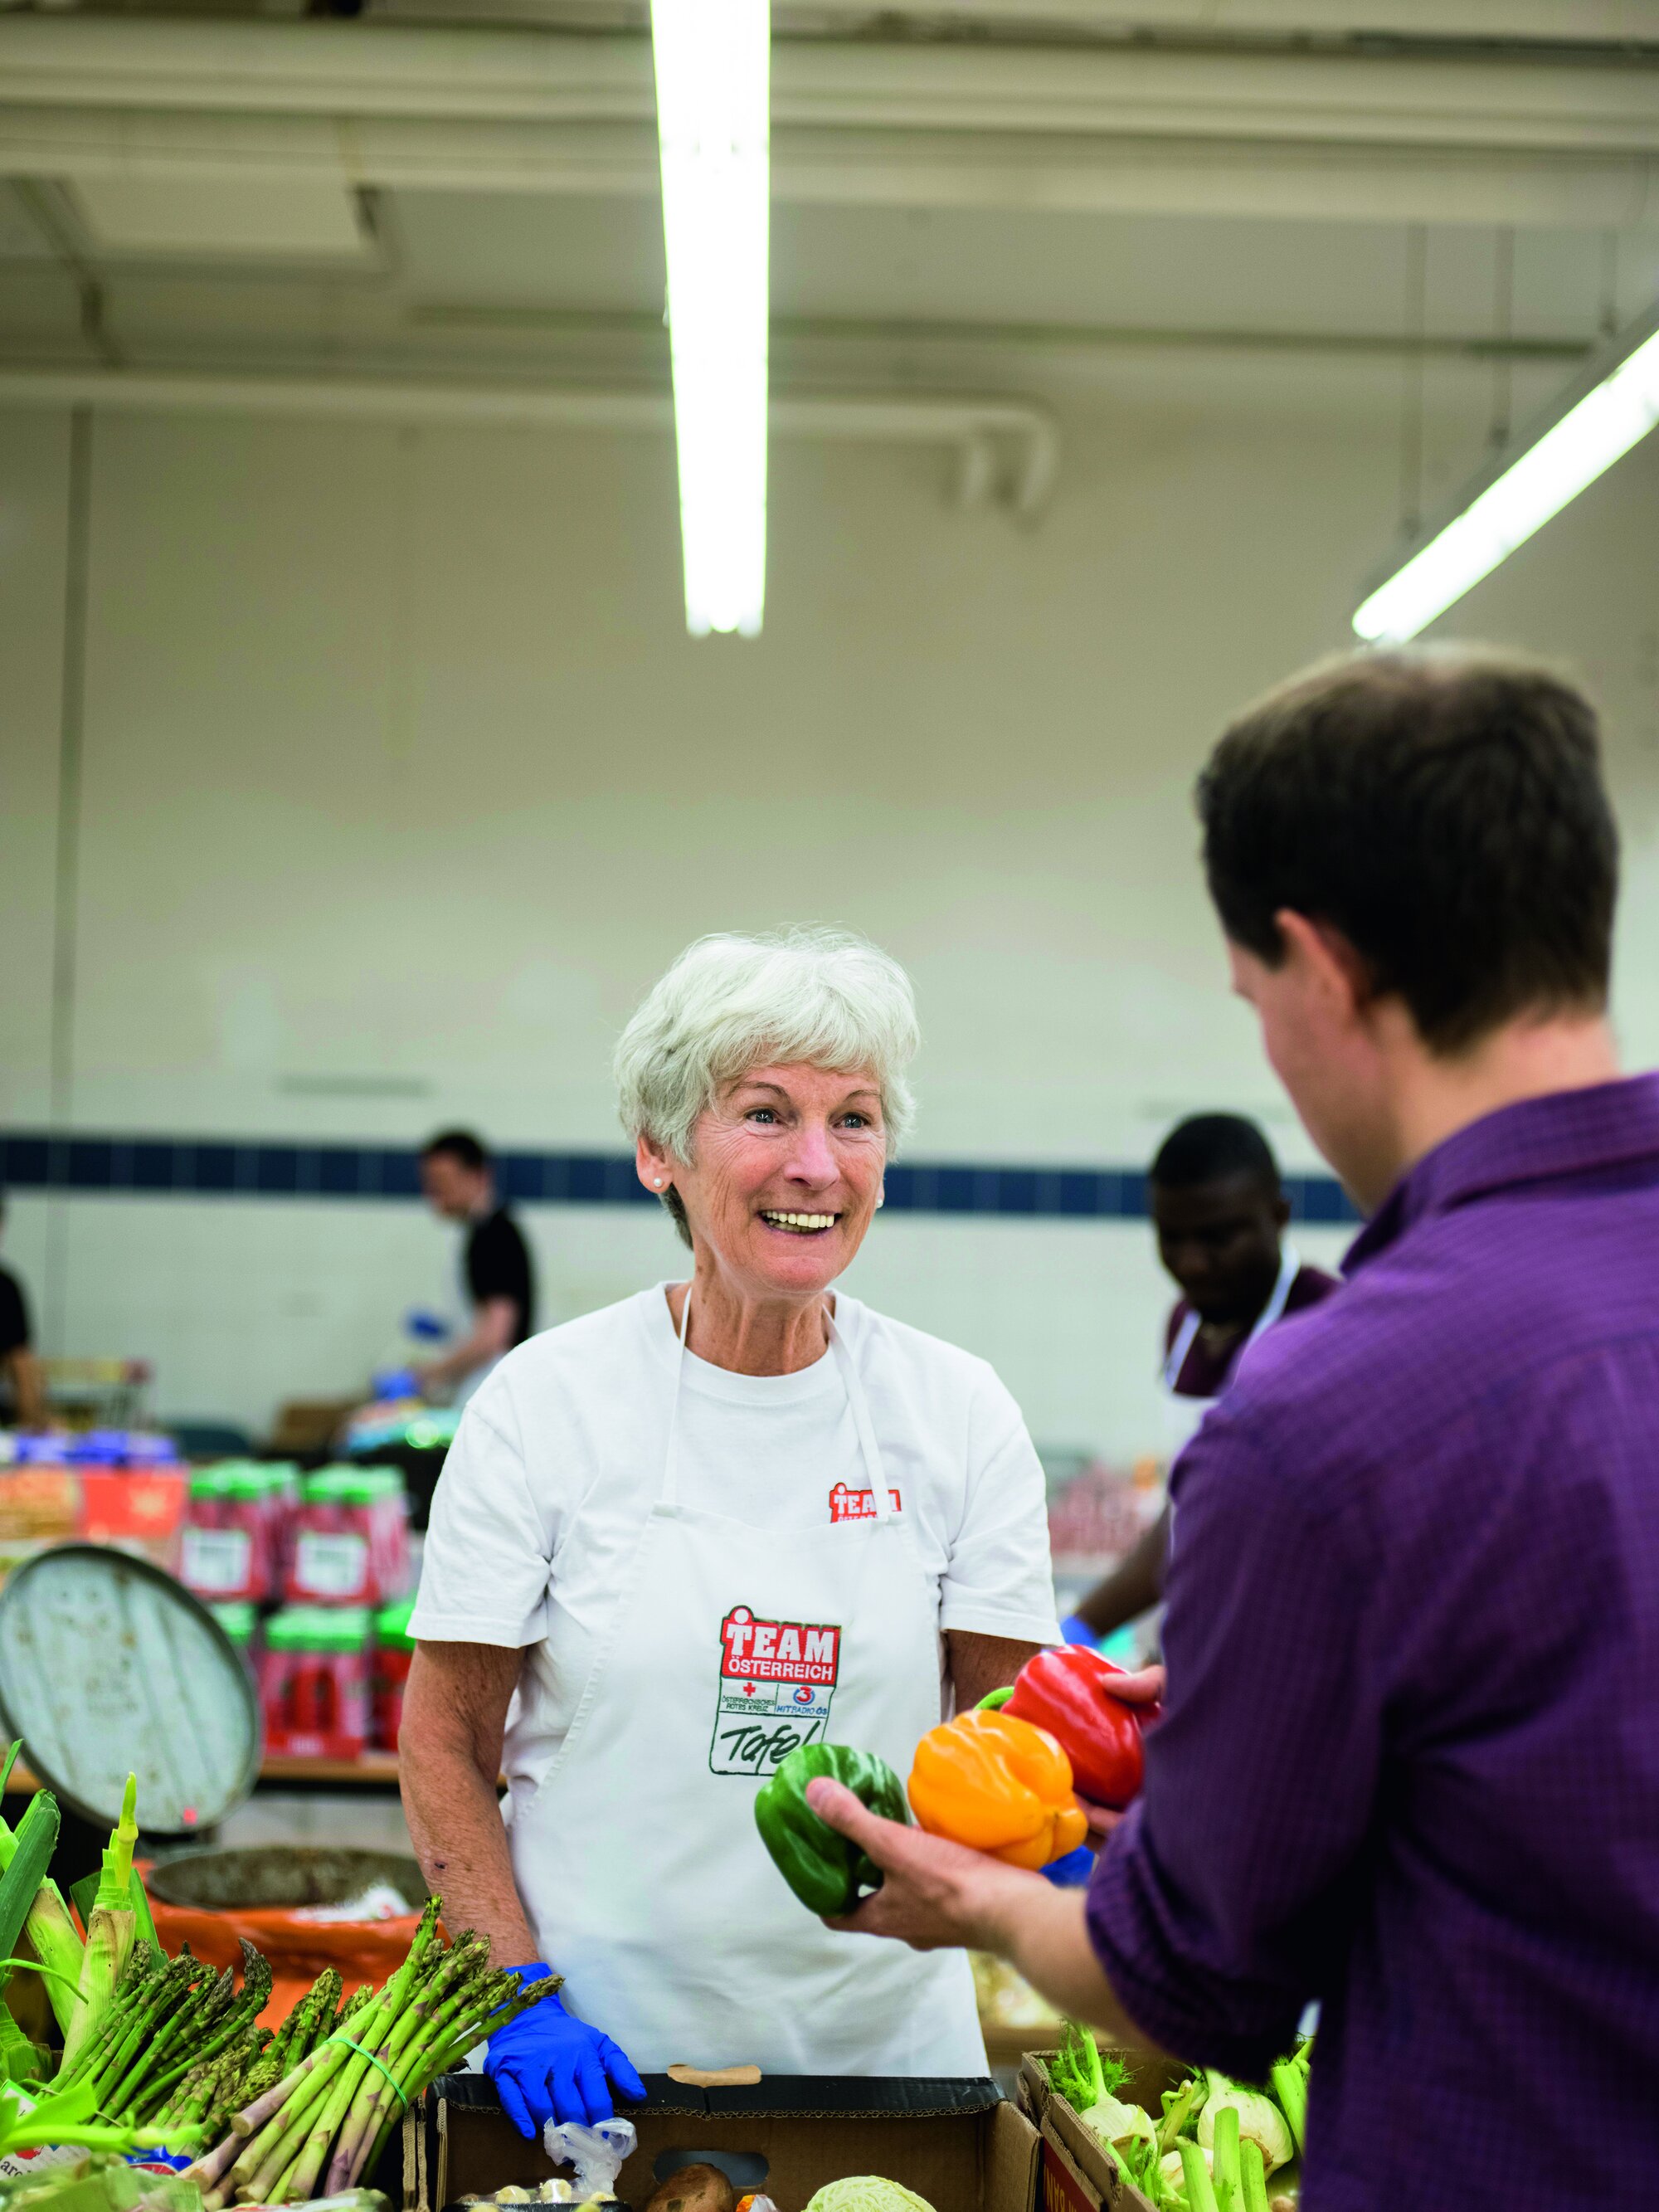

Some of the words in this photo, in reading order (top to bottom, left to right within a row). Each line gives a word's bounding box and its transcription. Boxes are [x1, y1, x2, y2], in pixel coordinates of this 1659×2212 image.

[726, 1624, 834, 1663] TEAM
[728, 1655, 833, 1680] ÖSTERREICH
[776, 1705, 814, 1715] HITRADIO
